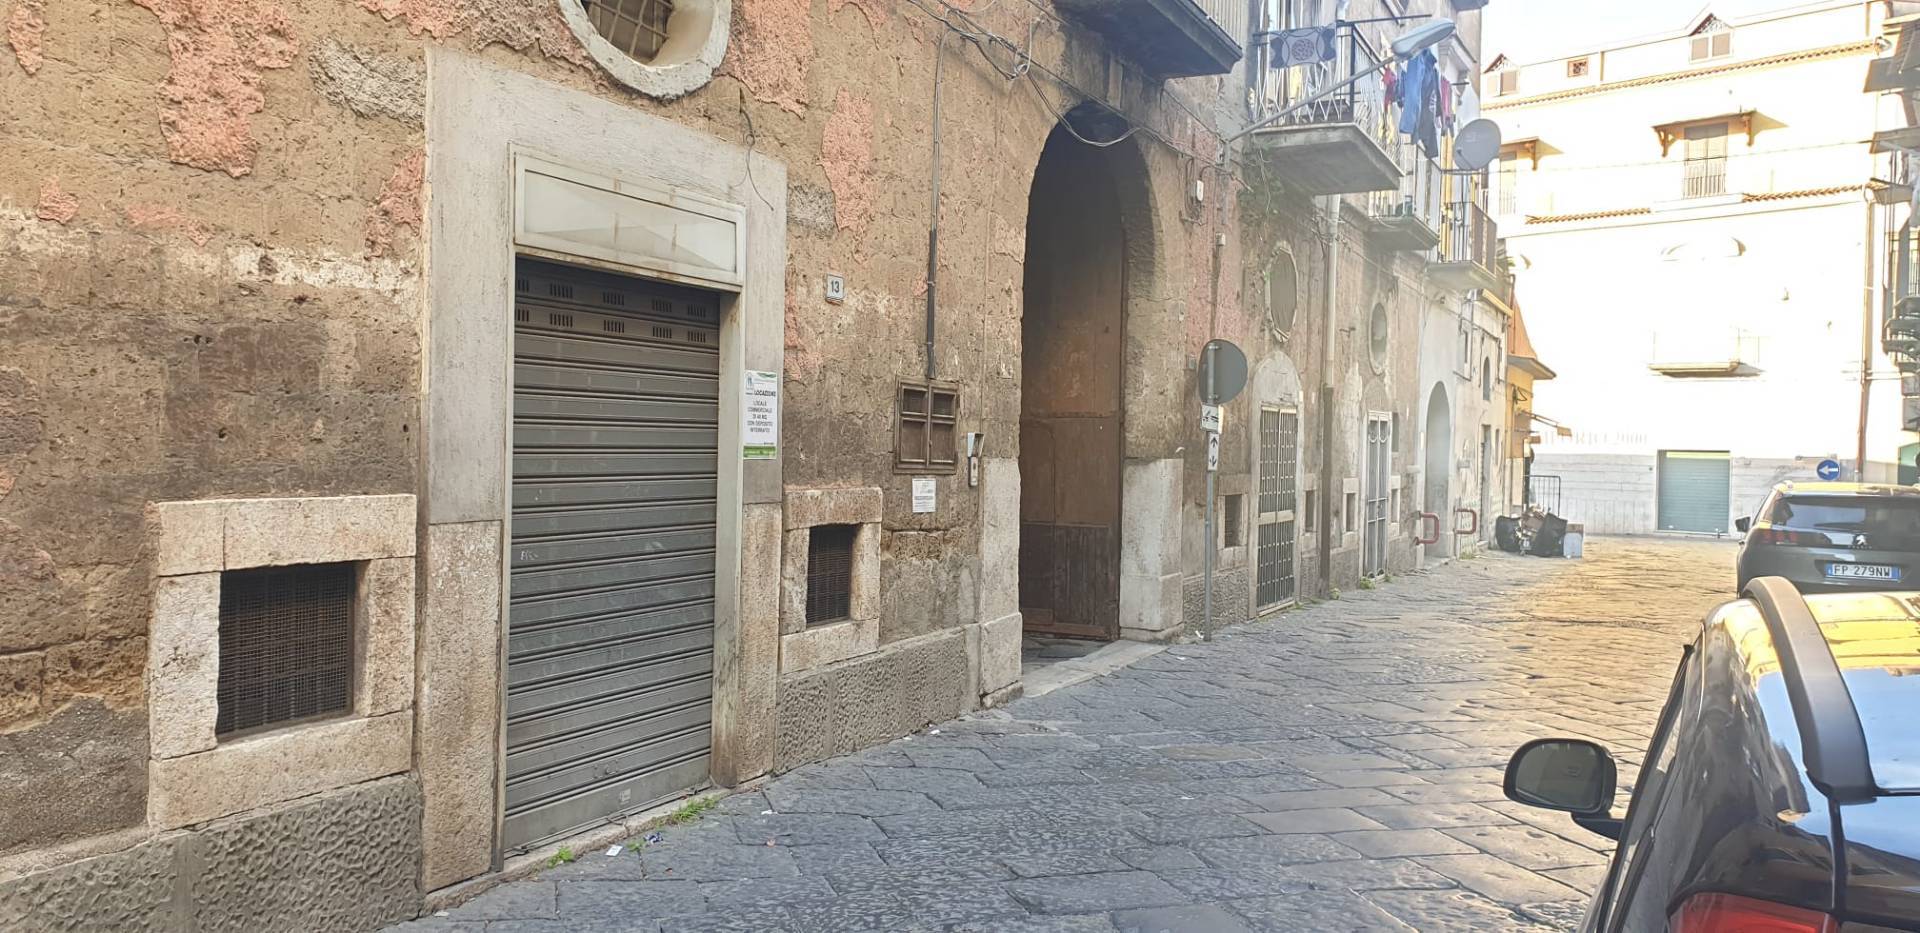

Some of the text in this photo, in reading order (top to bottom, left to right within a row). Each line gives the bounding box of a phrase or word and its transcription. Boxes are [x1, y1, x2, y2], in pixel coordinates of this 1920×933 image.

[830, 280, 840, 293] 13
[1833, 565, 1890, 577] FP 279NW
